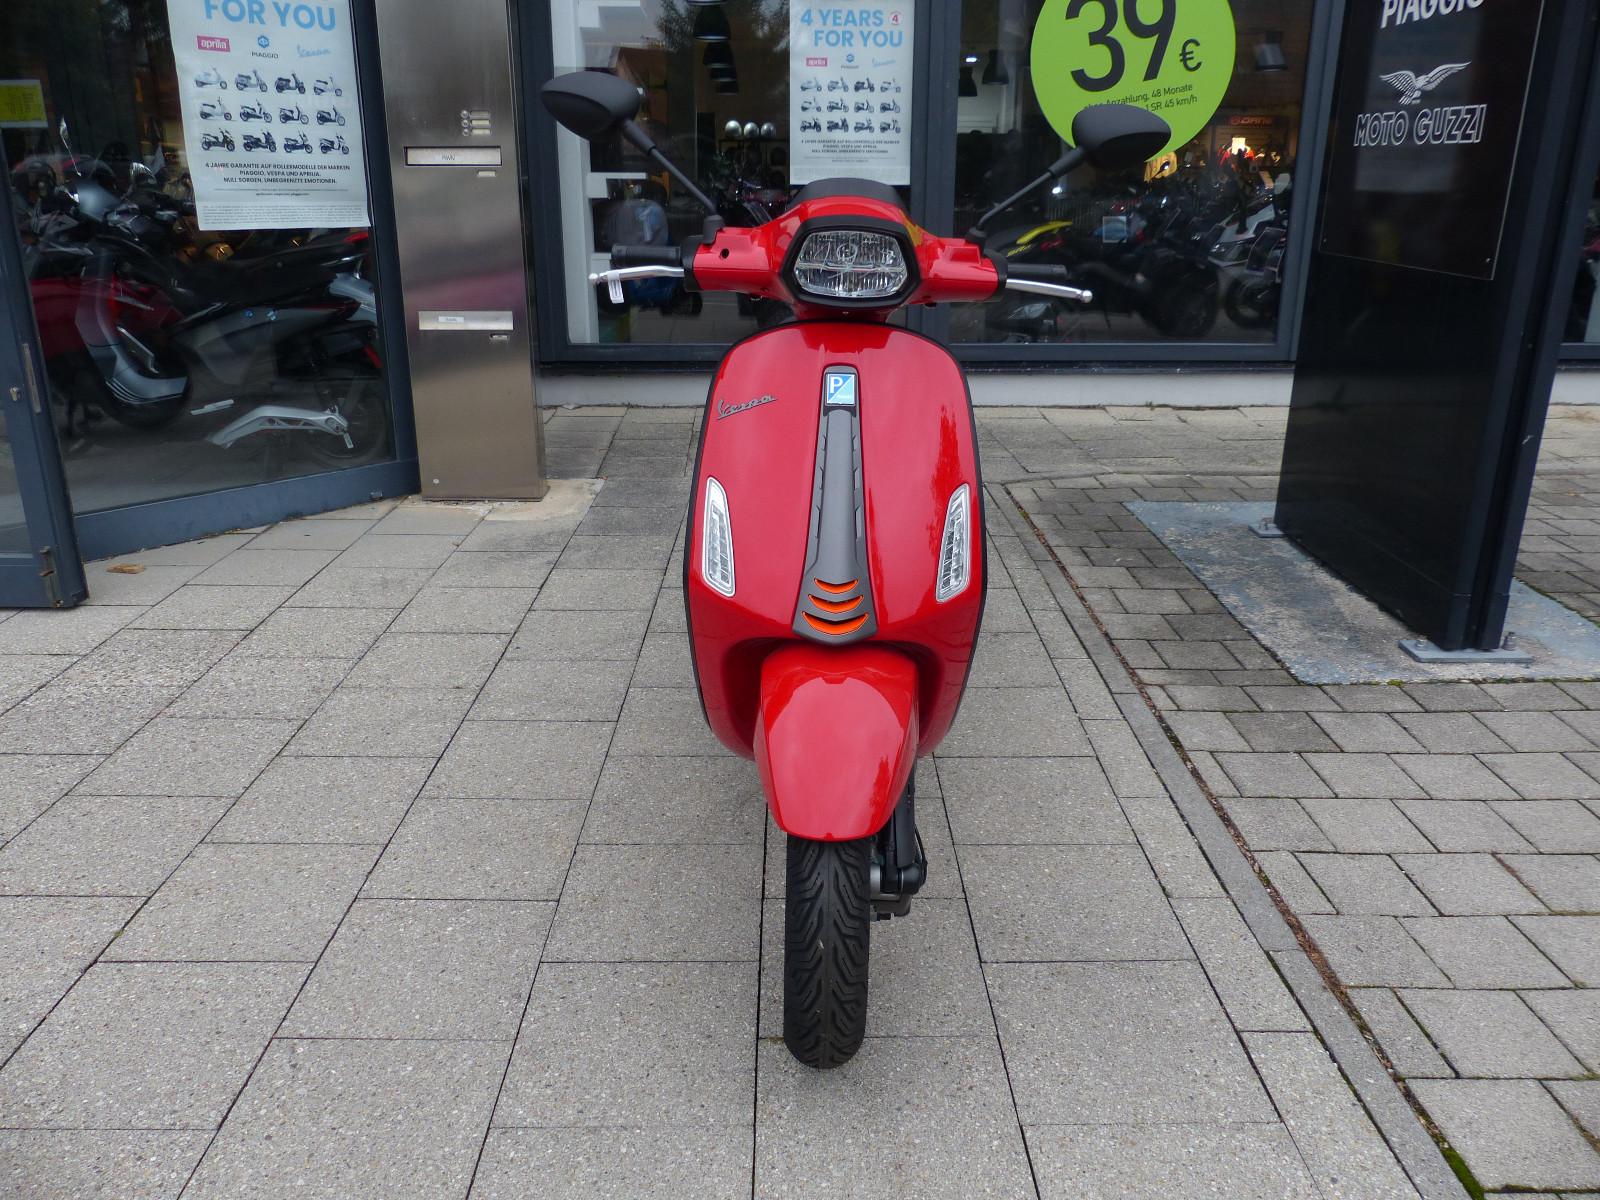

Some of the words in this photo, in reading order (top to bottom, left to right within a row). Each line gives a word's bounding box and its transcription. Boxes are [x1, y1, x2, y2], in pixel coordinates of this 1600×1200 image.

[204, 0, 266, 25] FOR
[272, 1, 336, 31] YOU
[800, 9, 813, 26] 4
[819, 9, 884, 27] YEARS
[1381, 0, 1484, 29] PIAG
[201, 39, 227, 50] aprilia
[814, 30, 854, 47] FOR
[860, 30, 903, 48] YOU
[1065, 0, 1176, 92] 39
[1179, 38, 1202, 72] €
[251, 51, 279, 59] PIAGGIO
[1152, 88, 1161, 98] 48
[1164, 84, 1193, 96] Monate
[1165, 99, 1174, 108] 45
[1176, 94, 1198, 106] km/h
[1353, 110, 1409, 147] MOTO
[1414, 103, 1488, 145] GUZZI
[716, 394, 778, 420] Vespa
